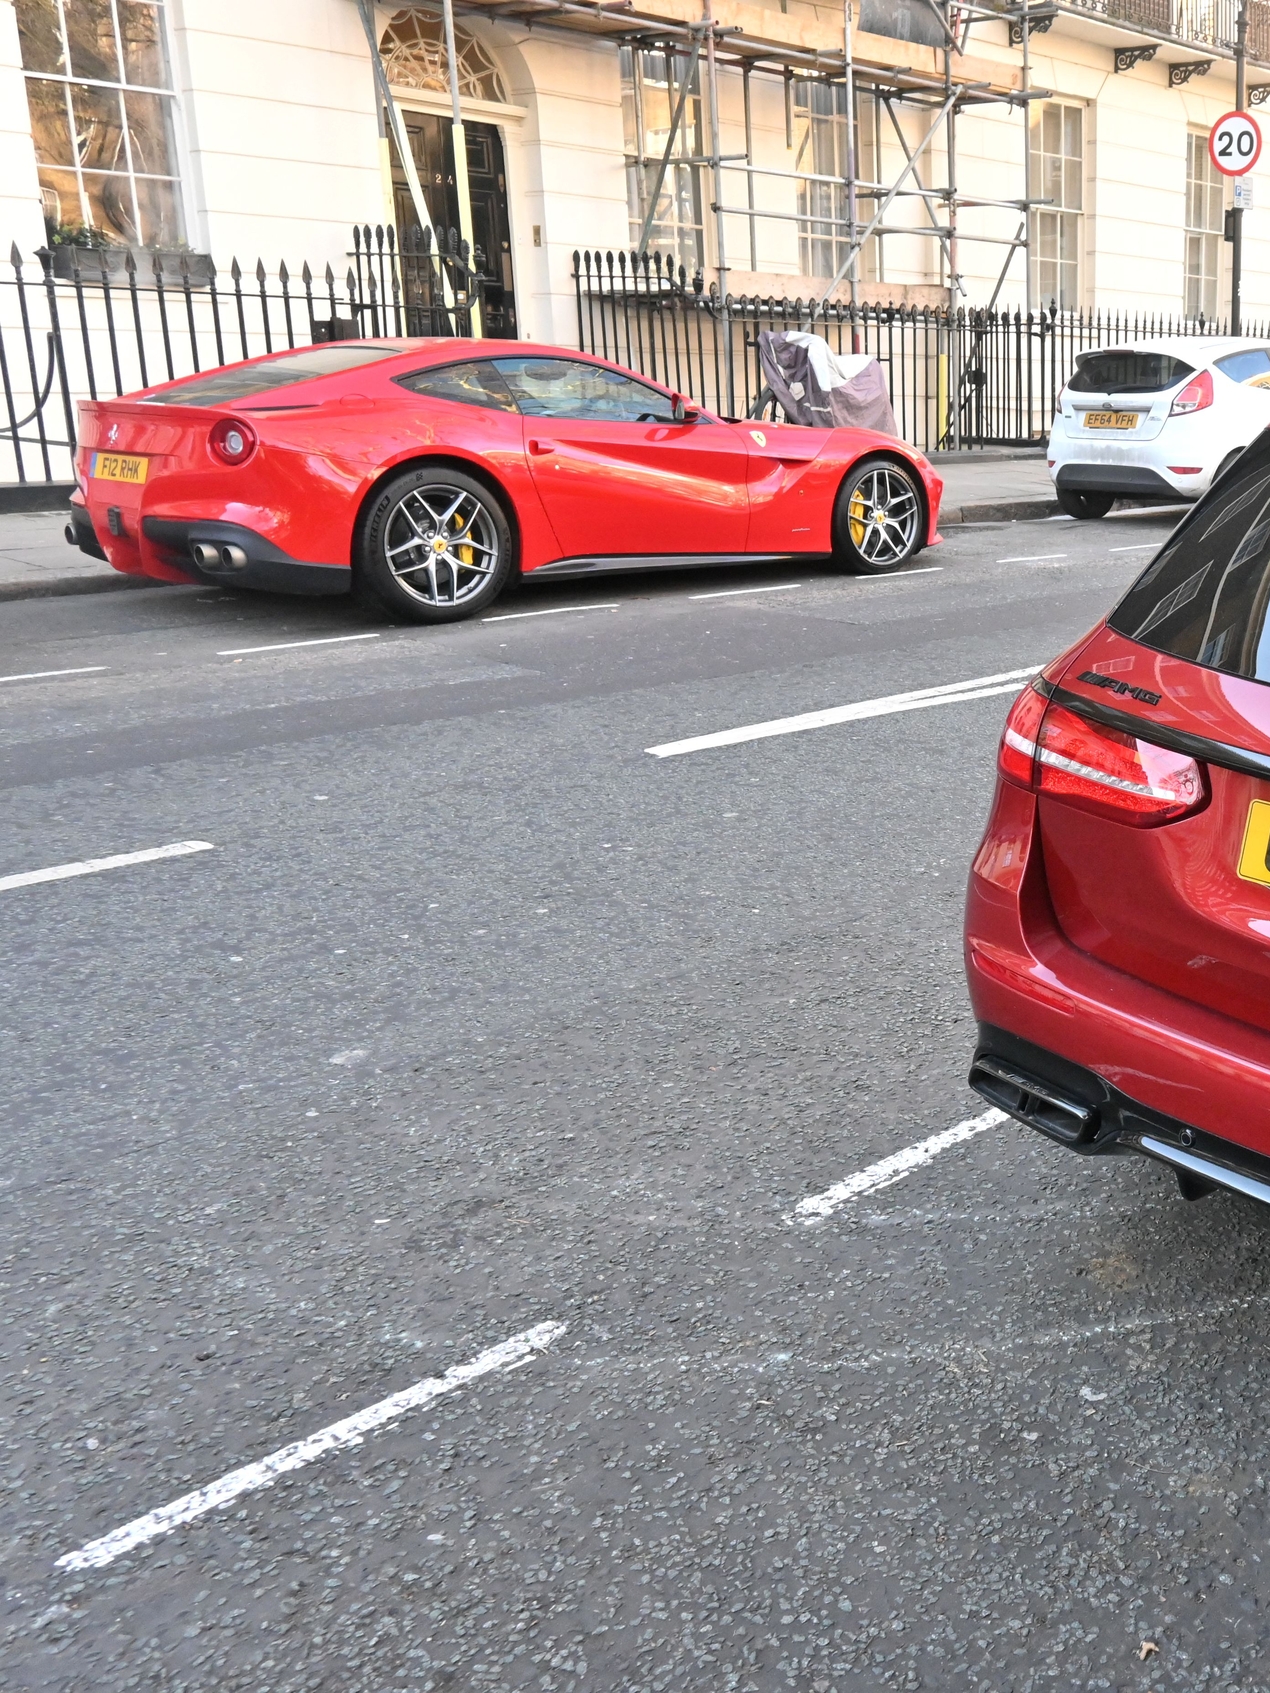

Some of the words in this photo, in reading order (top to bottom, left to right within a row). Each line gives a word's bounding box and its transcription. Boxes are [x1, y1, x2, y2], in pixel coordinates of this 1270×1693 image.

[1218, 130, 1254, 157] 20
[1087, 413, 1112, 425] EF64
[1115, 414, 1135, 426] VFH
[101, 457, 118, 477] F12
[119, 459, 141, 480] RHK
[370, 494, 390, 543] ICHELIN
[1101, 677, 1162, 706] AMG
